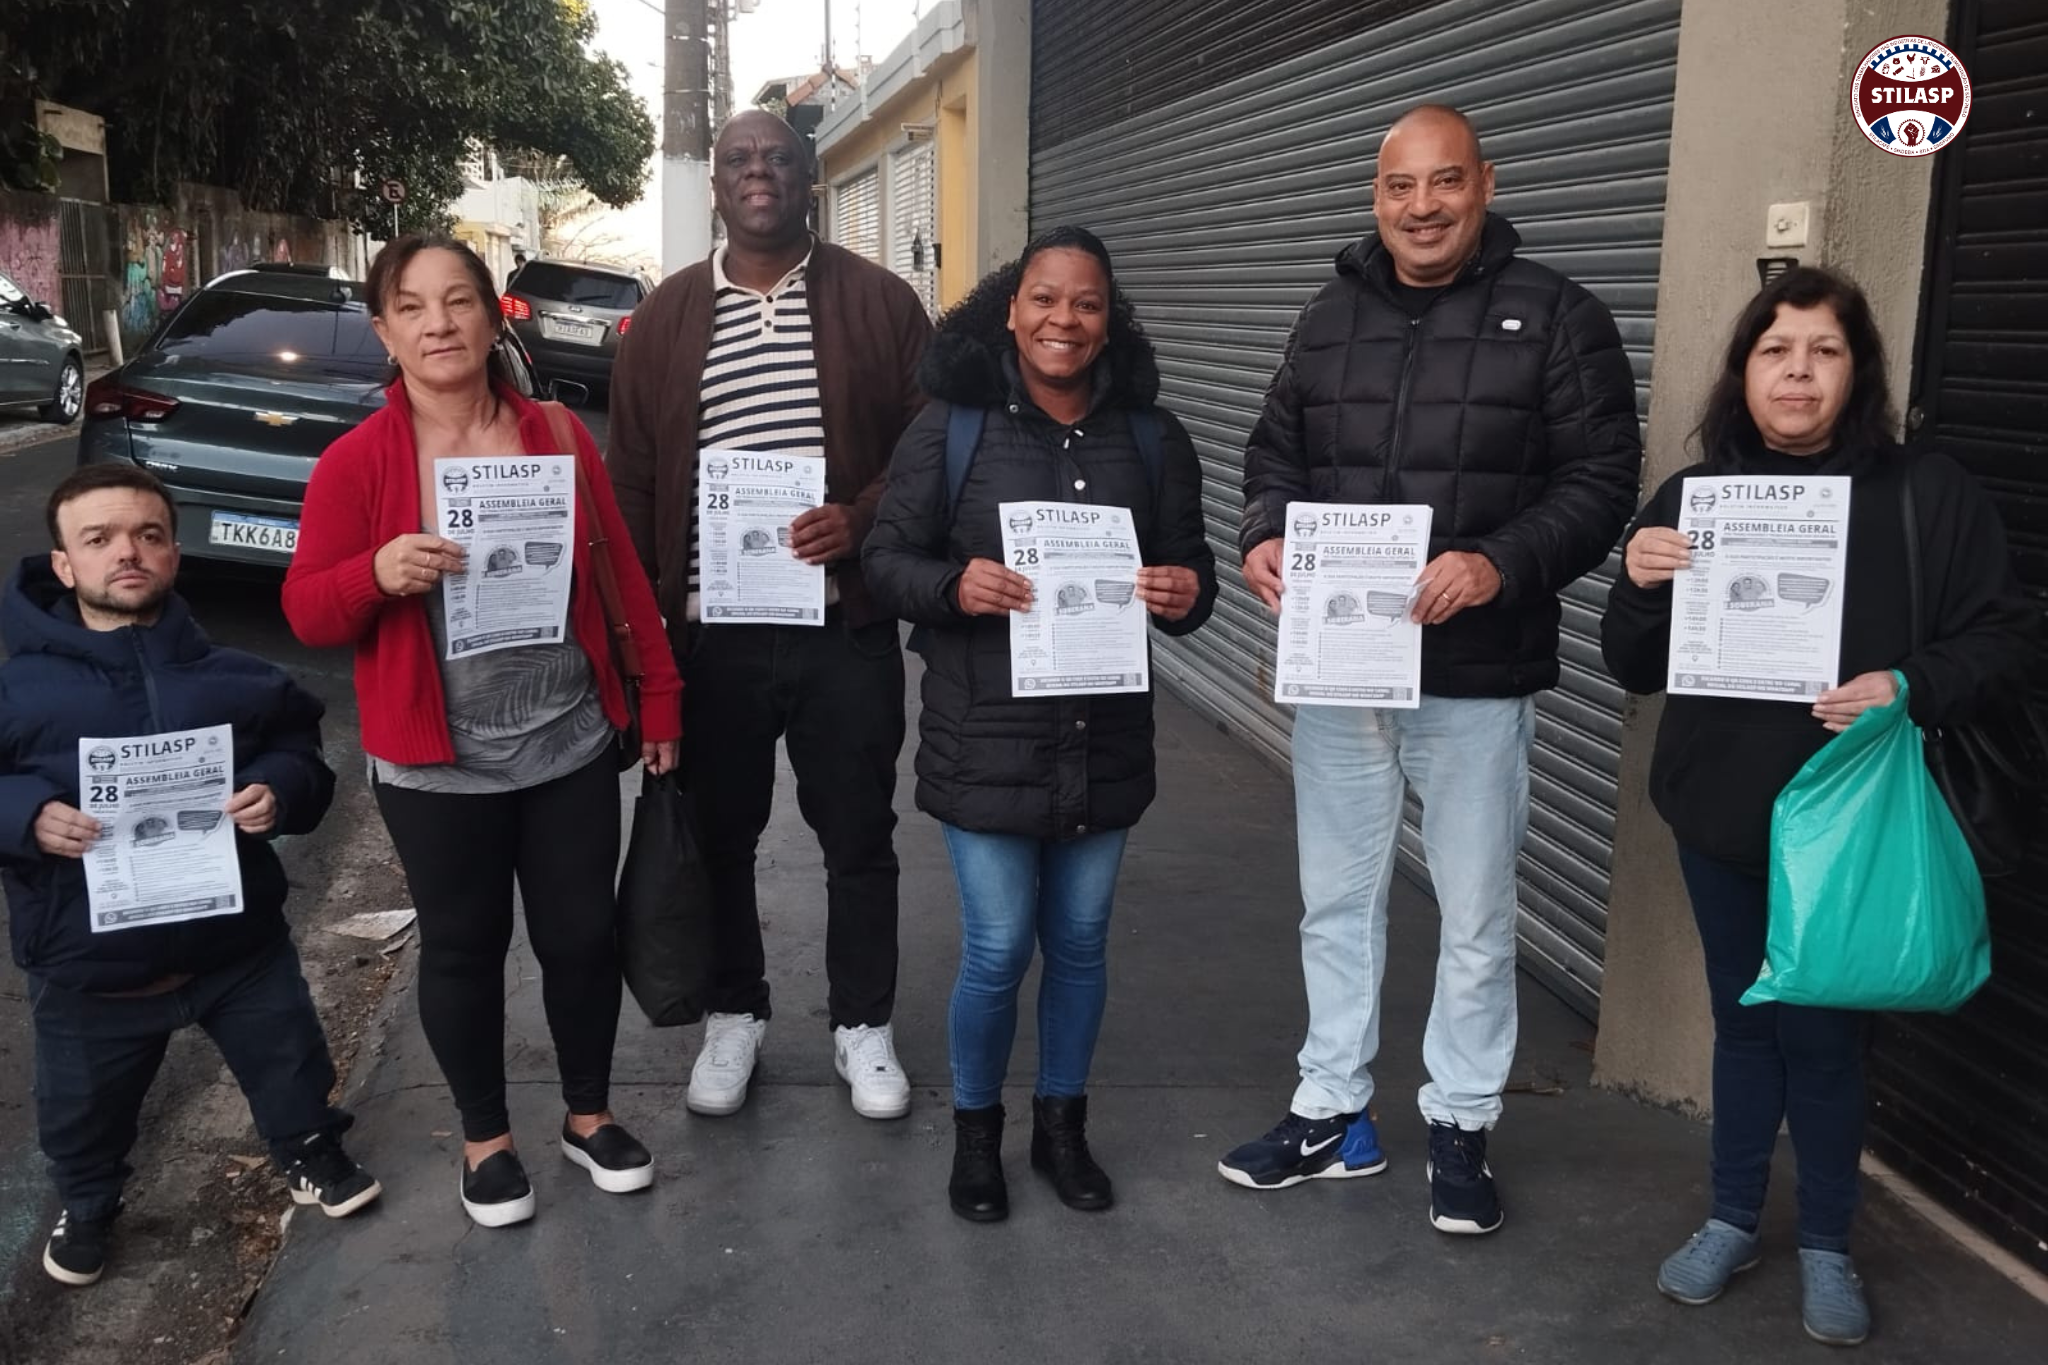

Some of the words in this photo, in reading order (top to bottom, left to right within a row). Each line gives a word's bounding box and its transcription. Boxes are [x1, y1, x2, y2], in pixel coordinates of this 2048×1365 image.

[472, 464, 541, 480] STILASP
[732, 457, 793, 473] STILASP
[735, 487, 788, 496] ASSEMBLEIA
[791, 491, 815, 500] GERAL
[1722, 485, 1805, 500] STILASP
[479, 498, 536, 509] ASSEMBLEIA
[539, 497, 566, 506] GERAL
[707, 493, 729, 509] 28
[448, 509, 473, 528] 28
[1036, 509, 1100, 524] STILASP
[1322, 513, 1391, 526] STILASP
[221, 523, 295, 549] TKK6A8
[1724, 522, 1795, 533] ASSEMBLEIA
[1799, 524, 1837, 534] GERAL
[1044, 539, 1100, 548] ASSEMBLEIA
[1102, 541, 1131, 549] GERAL
[1687, 530, 1715, 550] 28
[1014, 548, 1039, 566] 28
[1323, 546, 1381, 555] ASSEMBLEIA
[1385, 547, 1415, 556] GERAL
[1291, 553, 1316, 571] 28
[120, 737, 196, 759] STILASP
[126, 772, 191, 785] ASSEMBLEIA
[193, 765, 224, 777] GERAL
[90, 785, 119, 803] 28
